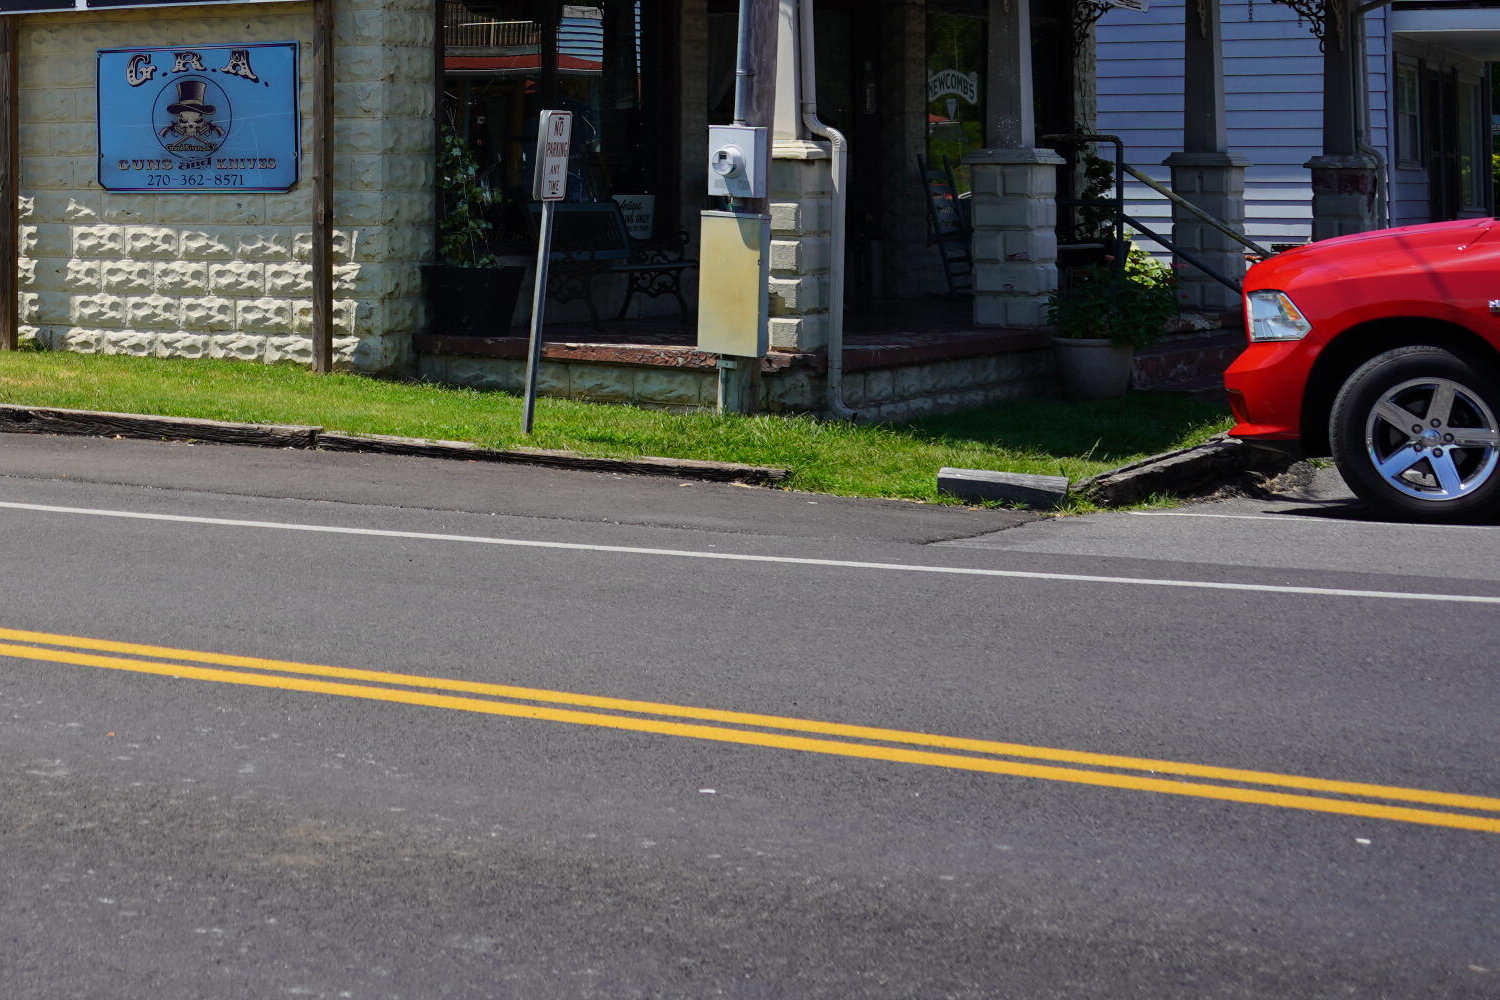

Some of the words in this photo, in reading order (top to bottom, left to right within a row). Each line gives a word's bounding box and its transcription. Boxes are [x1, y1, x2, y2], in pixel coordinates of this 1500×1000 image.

[554, 120, 564, 136] NO
[546, 141, 568, 157] PARKING
[116, 158, 173, 171] GUNS
[178, 156, 212, 171] and
[216, 157, 277, 170] KNIVES
[550, 163, 561, 174] ANY
[548, 180, 560, 191] TIME
